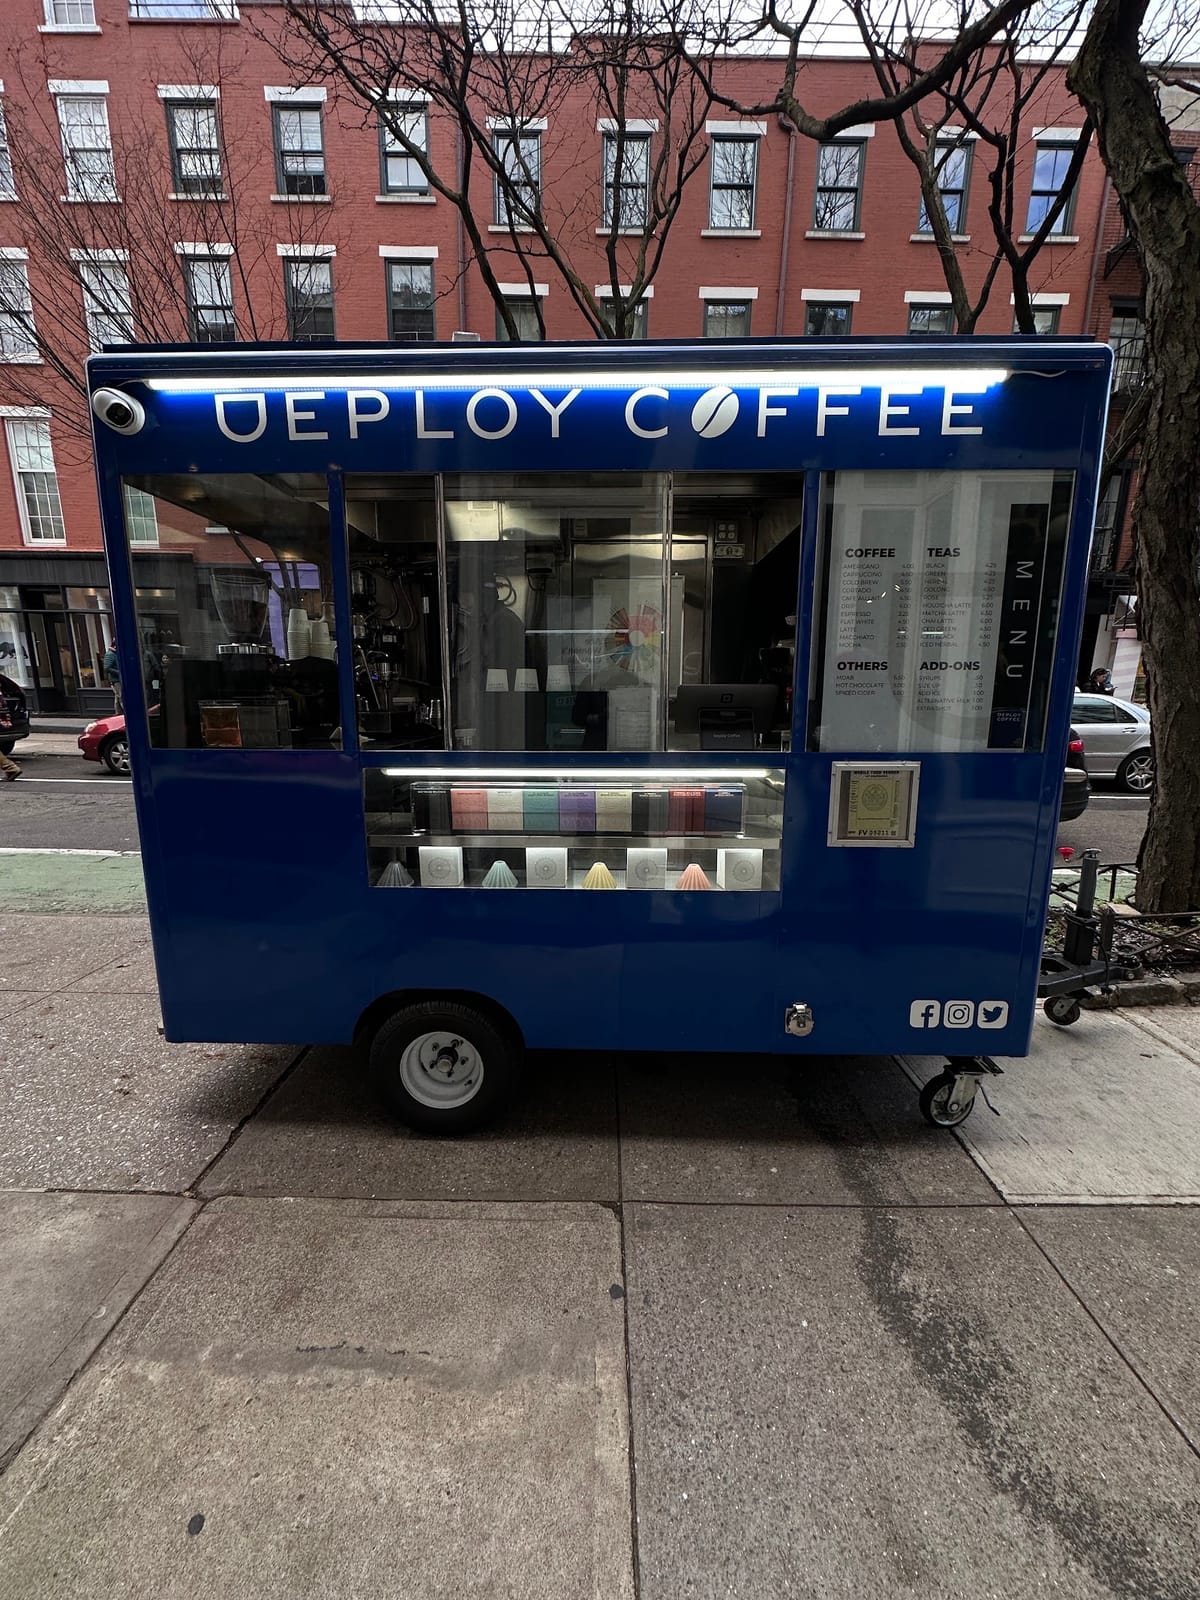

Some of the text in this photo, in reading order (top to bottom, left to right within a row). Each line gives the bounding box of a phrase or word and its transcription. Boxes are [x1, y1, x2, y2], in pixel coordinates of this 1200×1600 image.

[214, 388, 583, 443] DEPLOY
[845, 548, 896, 558] COFFEE
[927, 547, 960, 558] TEAS
[1006, 561, 1034, 678] MENU
[837, 661, 888, 670] OTHERS
[920, 661, 980, 670] ADD-ONS
